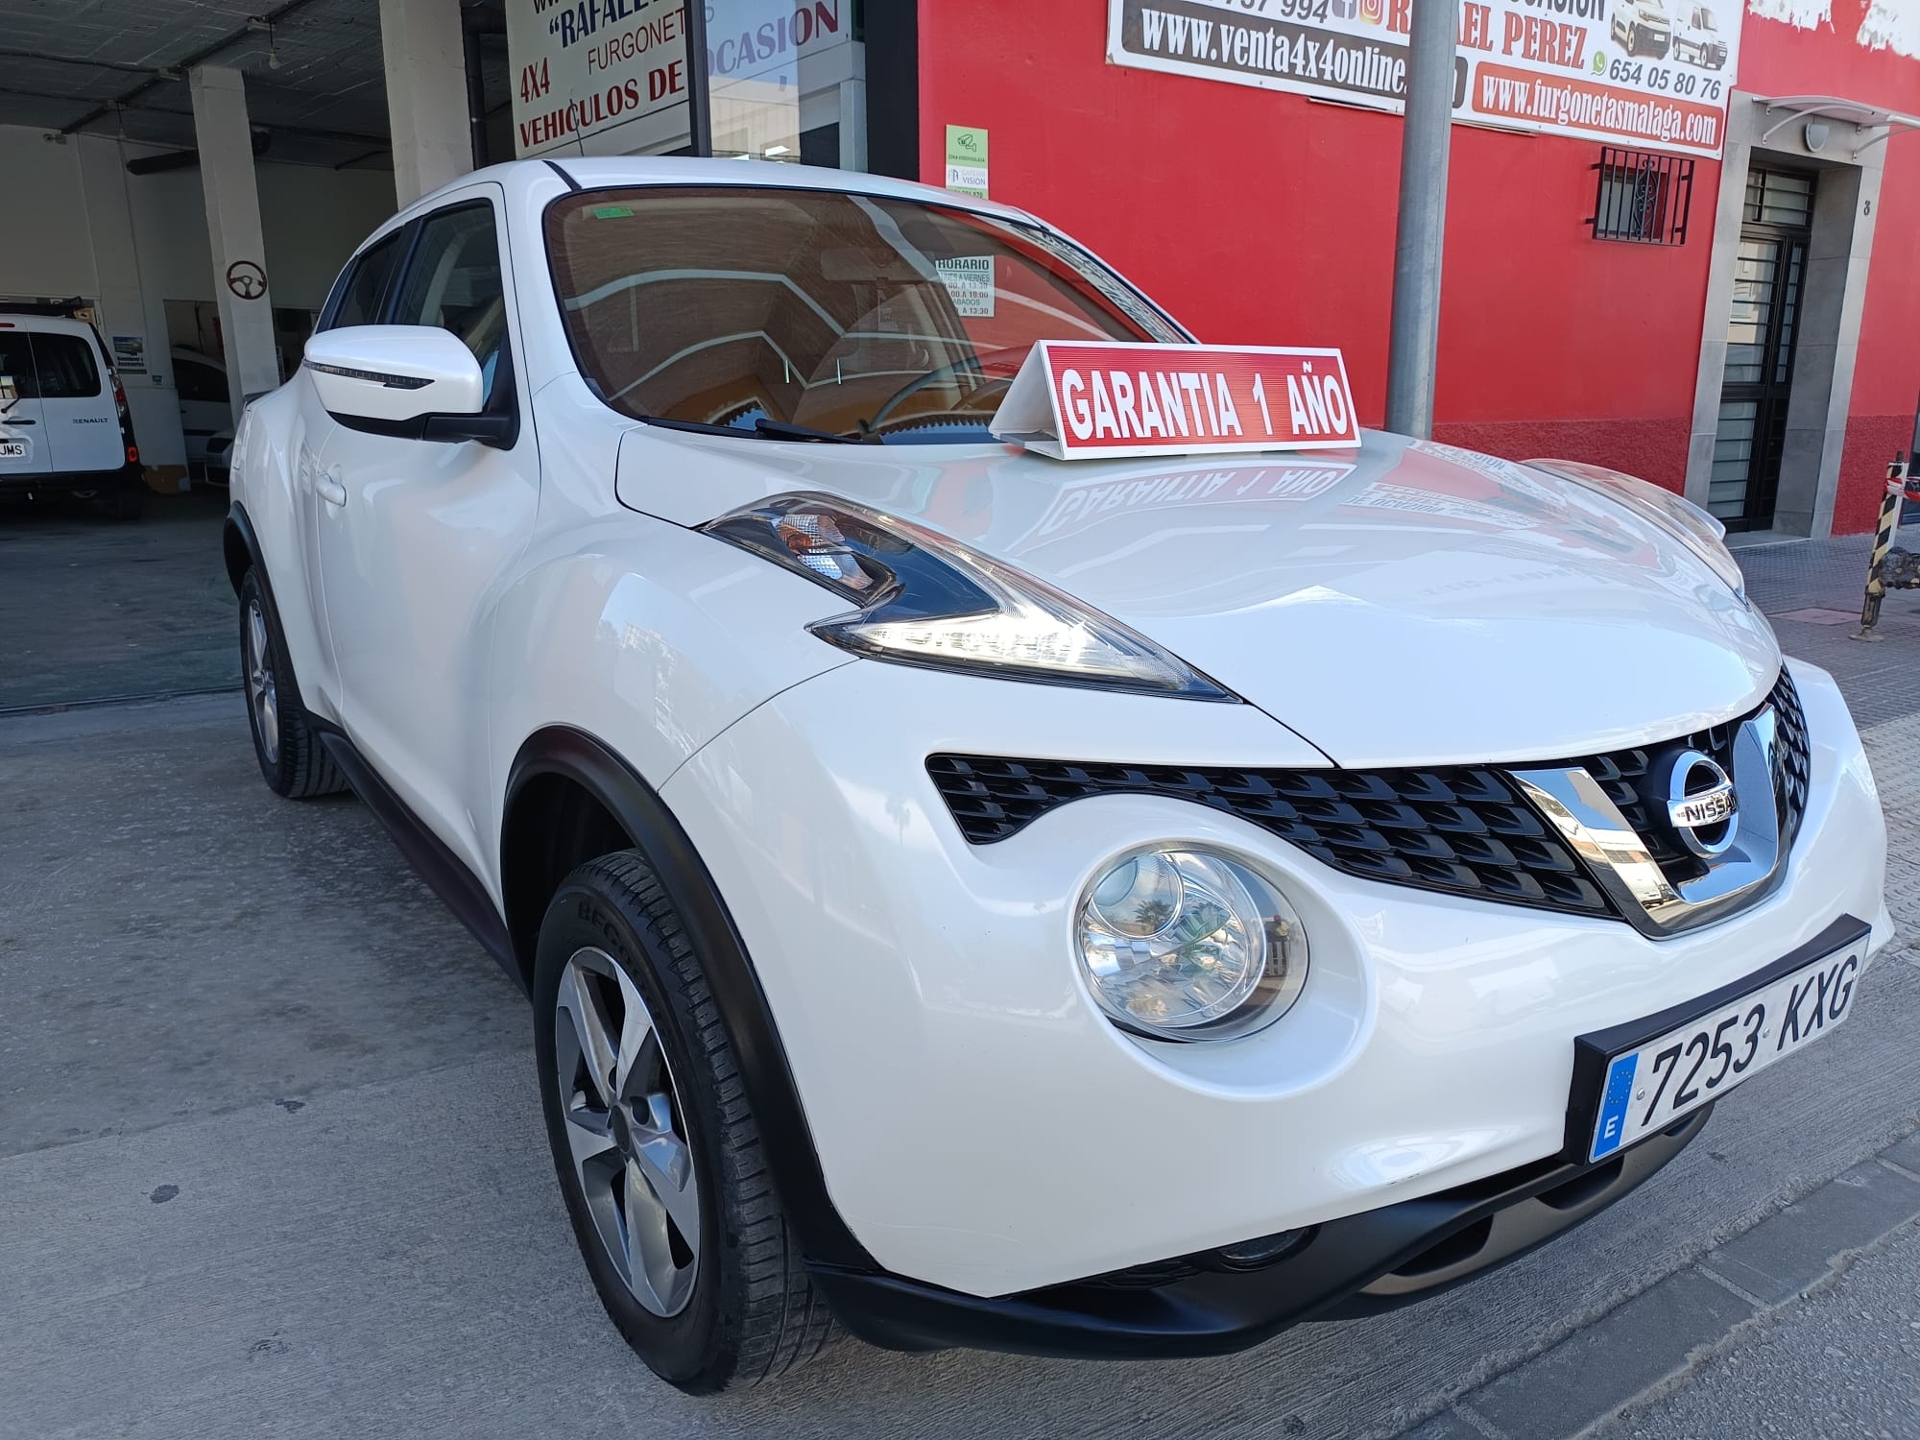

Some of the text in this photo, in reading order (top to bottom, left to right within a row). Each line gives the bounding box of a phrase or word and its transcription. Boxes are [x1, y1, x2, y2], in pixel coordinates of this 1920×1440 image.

[1502, 11, 1588, 69] PEREZ
[520, 57, 551, 103] 4X4
[1609, 59, 1721, 101] 654 05 80 76
[520, 78, 640, 148] VEHICULOS
[648, 59, 685, 102] DE
[1482, 74, 1717, 145] www.furgonetasmalaga.com
[962, 177, 986, 185] VISION
[938, 259, 989, 270] HORARIO
[73, 417, 108, 425] RENAULT
[1061, 360, 1348, 440] GARANTIA 1 AÑO
[0, 444, 23, 456] JMS
[1641, 954, 1857, 1127] 7253 KXG
[1604, 1115, 1618, 1139] E
